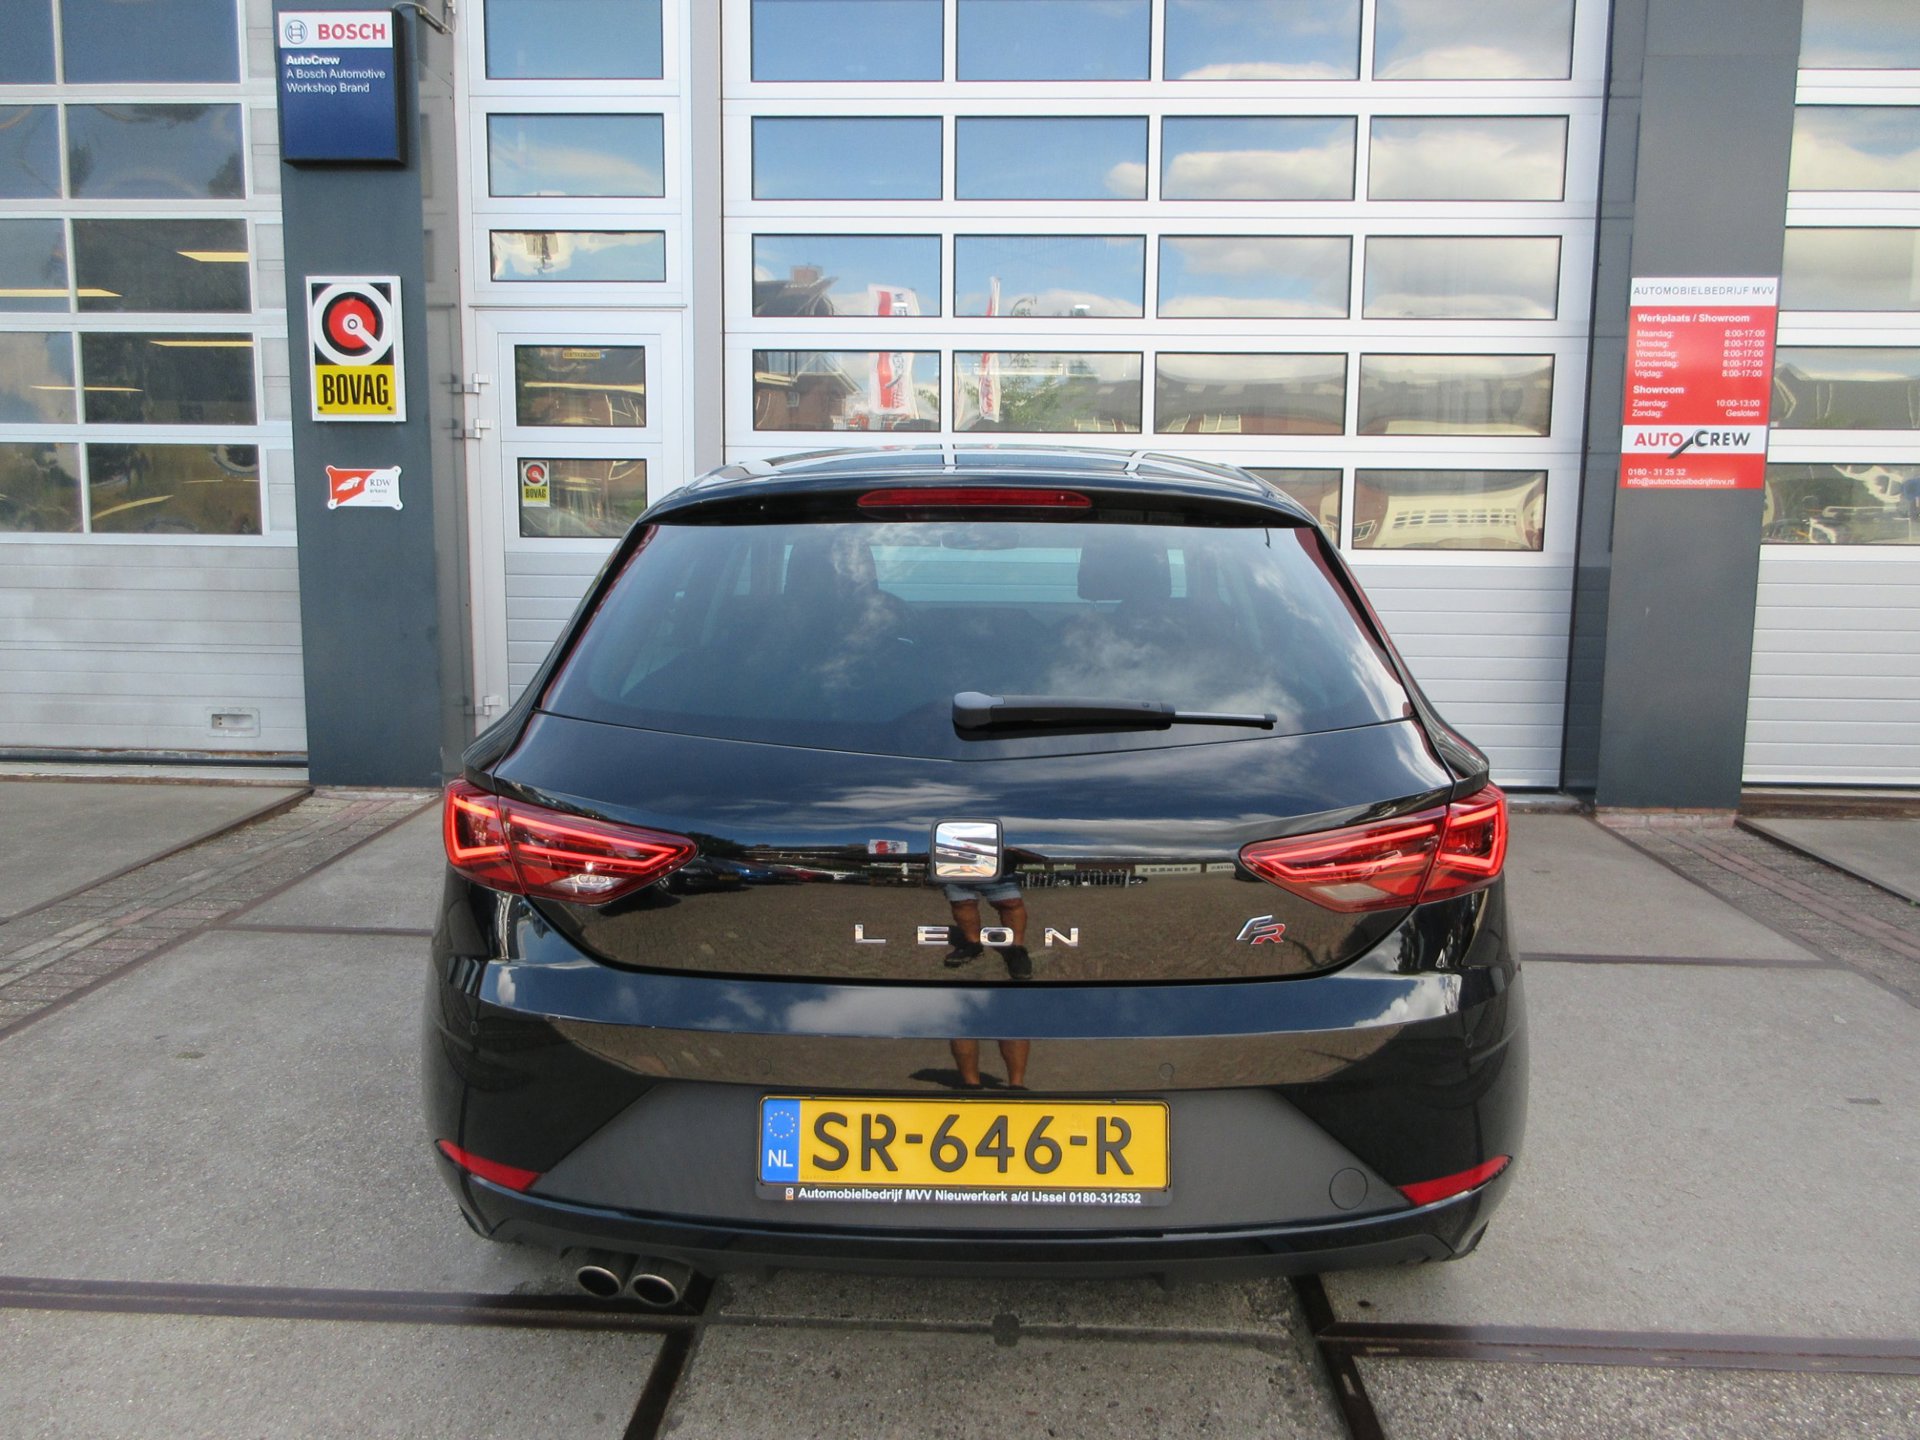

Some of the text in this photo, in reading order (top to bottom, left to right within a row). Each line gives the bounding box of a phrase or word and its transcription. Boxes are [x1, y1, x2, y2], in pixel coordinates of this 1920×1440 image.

[318, 23, 386, 40] BOSCH
[286, 55, 340, 66] AutoCrew
[286, 69, 386, 79] A Bosch Automotive
[287, 83, 370, 95] Workshop Brand
[1633, 286, 1775, 296] AUTOMOBIELBEDRIJF MVV
[1637, 313, 1690, 324] Werkplaats
[1699, 314, 1750, 322] Showroom
[322, 373, 389, 406] BOVAG
[1633, 385, 1684, 394] Showroom
[1632, 409, 1759, 418] Zondag: Gesloten
[1634, 429, 1751, 447] AUTO CREW
[1628, 468, 1647, 476] 0180
[1654, 468, 1663, 476] 31
[1665, 468, 1674, 476] 25
[1676, 468, 1686, 476] 32
[369, 479, 391, 487] RDW
[525, 487, 547, 499] BOVAG
[855, 924, 1079, 948] LEON
[812, 1111, 1134, 1175] SR-646-R
[767, 1149, 794, 1168] NL
[798, 1187, 1141, 1204] Automobielbedrijf MVV Nieuwerkerk a/d IJssel 0180-312532
